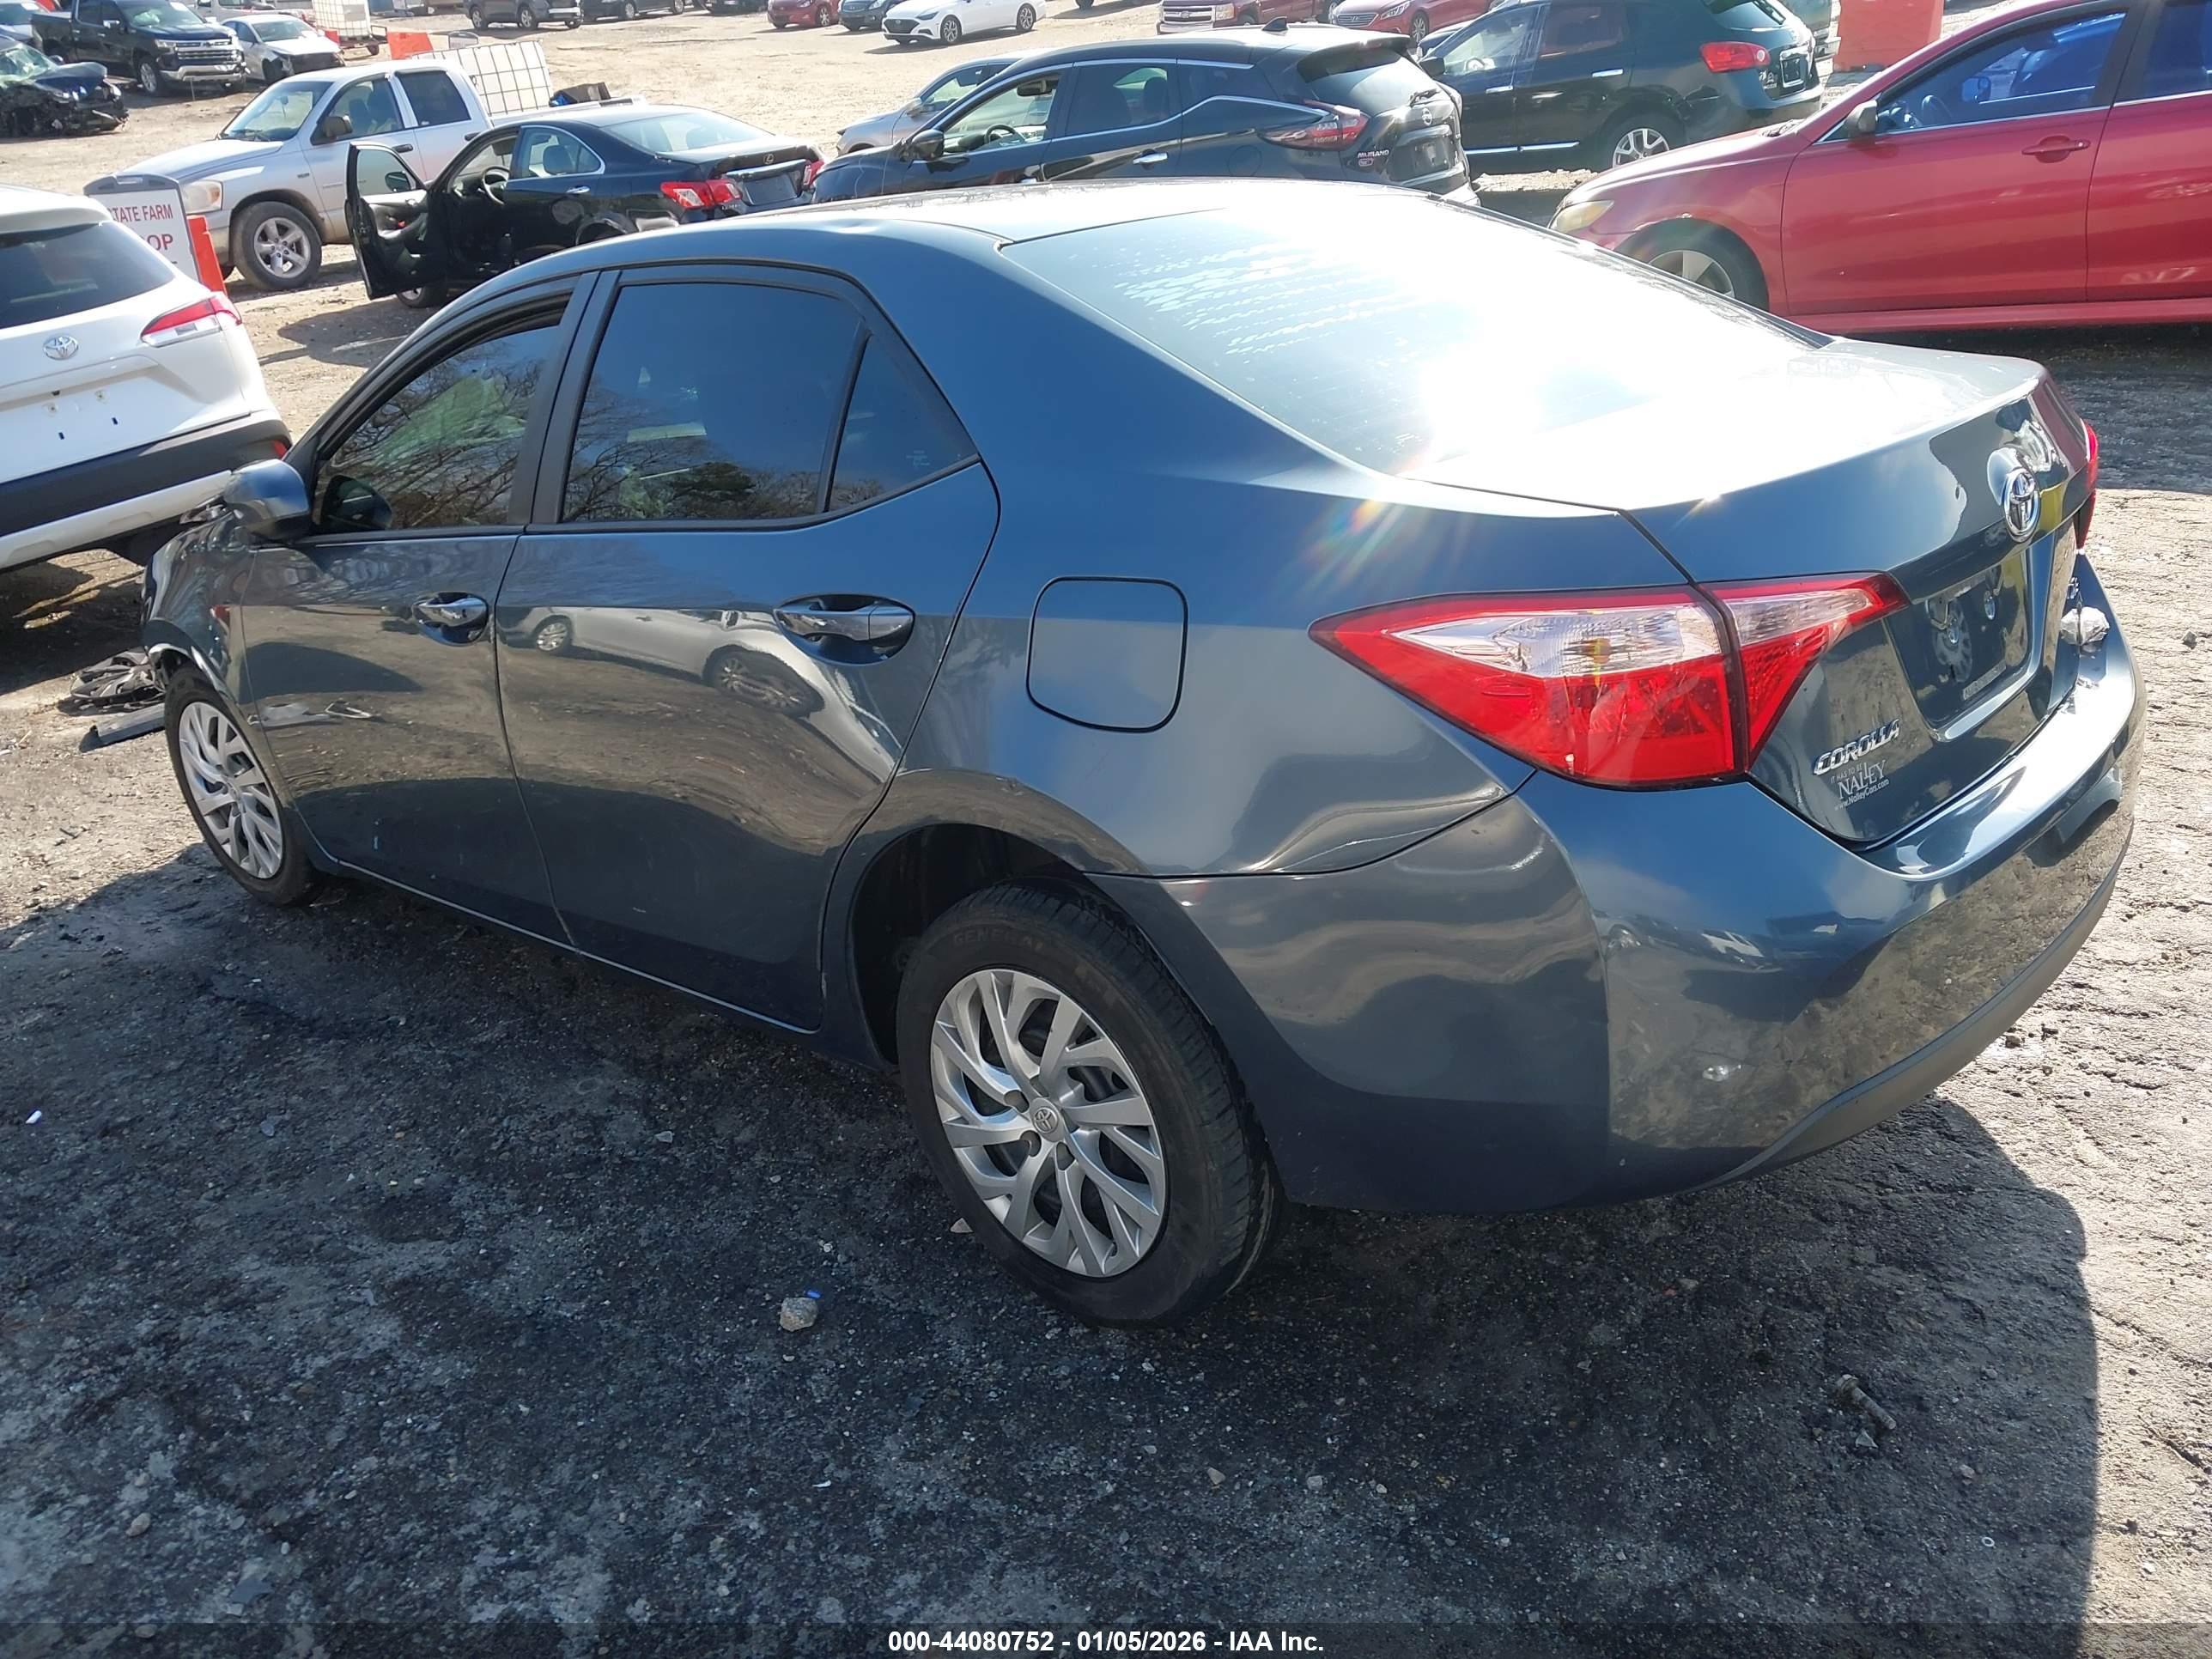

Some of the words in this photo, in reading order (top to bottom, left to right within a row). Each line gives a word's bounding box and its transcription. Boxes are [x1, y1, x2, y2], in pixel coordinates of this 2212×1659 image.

[106, 206, 141, 223] TATE
[143, 204, 173, 221] FARM
[140, 233, 173, 251] OP
[1813, 719, 1900, 775] COROLLA
[1838, 759, 1886, 799] NALLEY
